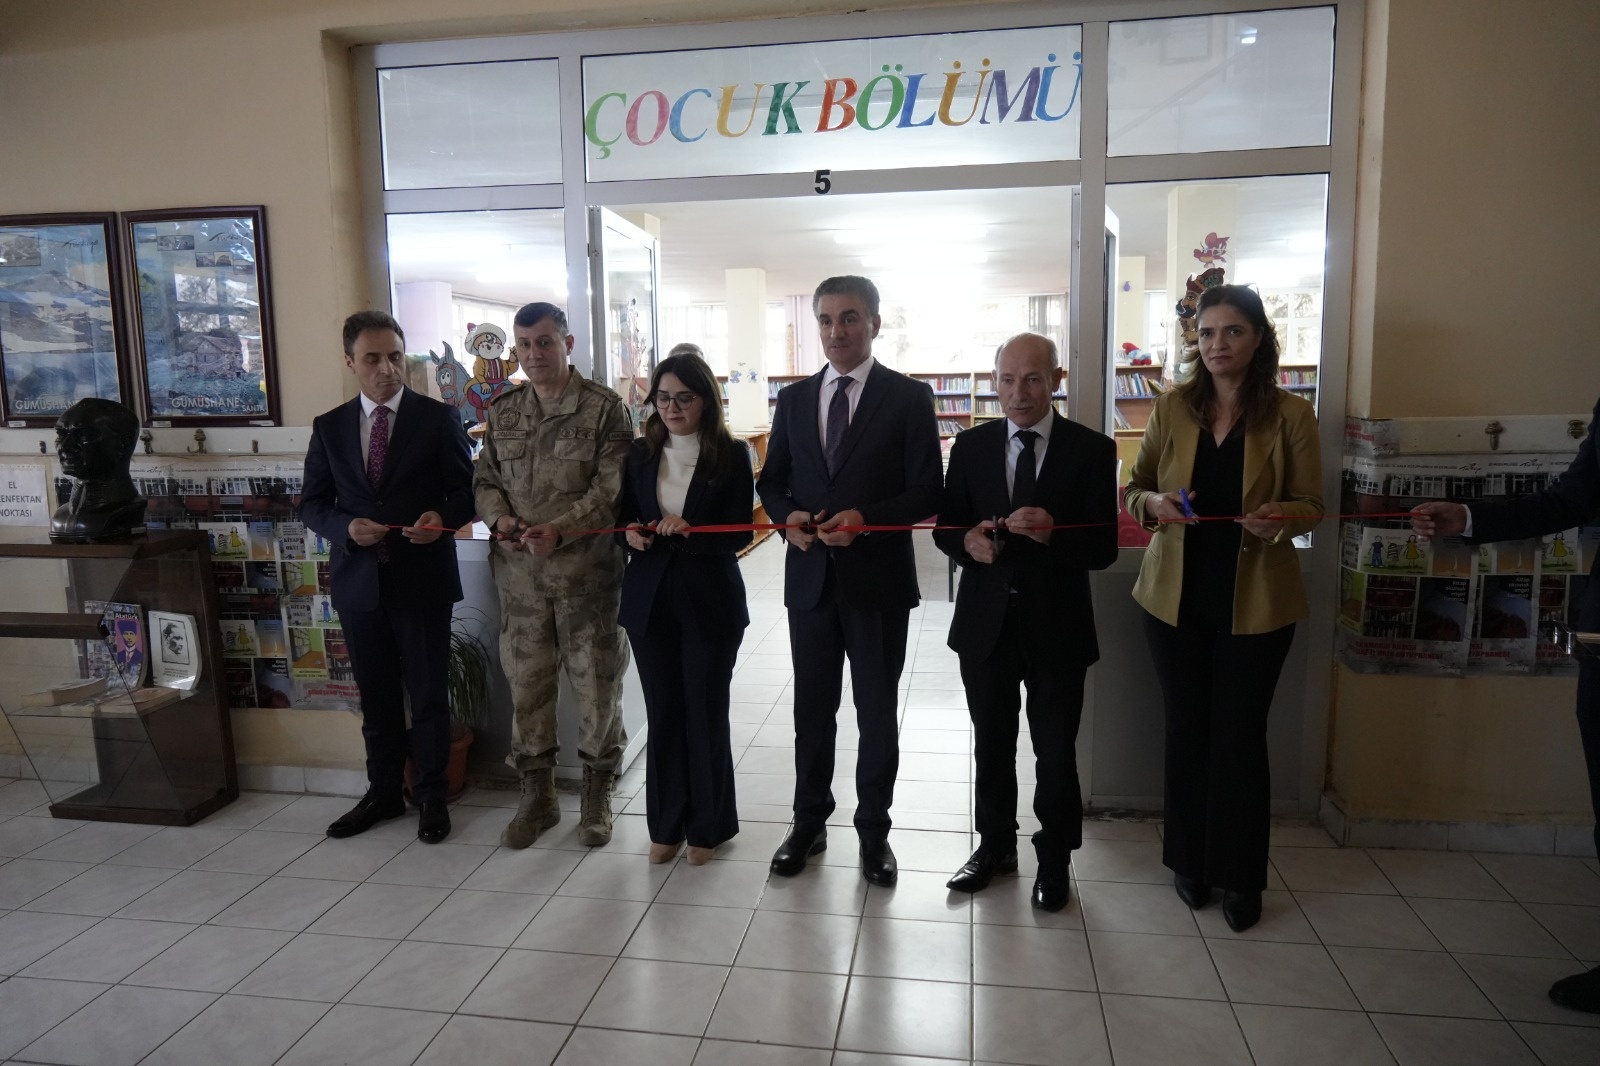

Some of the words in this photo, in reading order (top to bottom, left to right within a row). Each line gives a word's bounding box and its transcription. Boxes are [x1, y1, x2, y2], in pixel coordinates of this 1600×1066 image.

[585, 79, 811, 160] ÇOCUK
[814, 51, 1082, 133] BÖLÜMÜ
[814, 169, 832, 195] 5
[15, 397, 79, 411] GÜMÜŞHAN
[171, 395, 240, 409] GÜMÜŞHANE
[242, 404, 265, 413] SANTA
[8, 481, 18, 489] EL
[0, 495, 42, 503] ENFEKTAN
[115, 612, 139, 621] Atatürk
